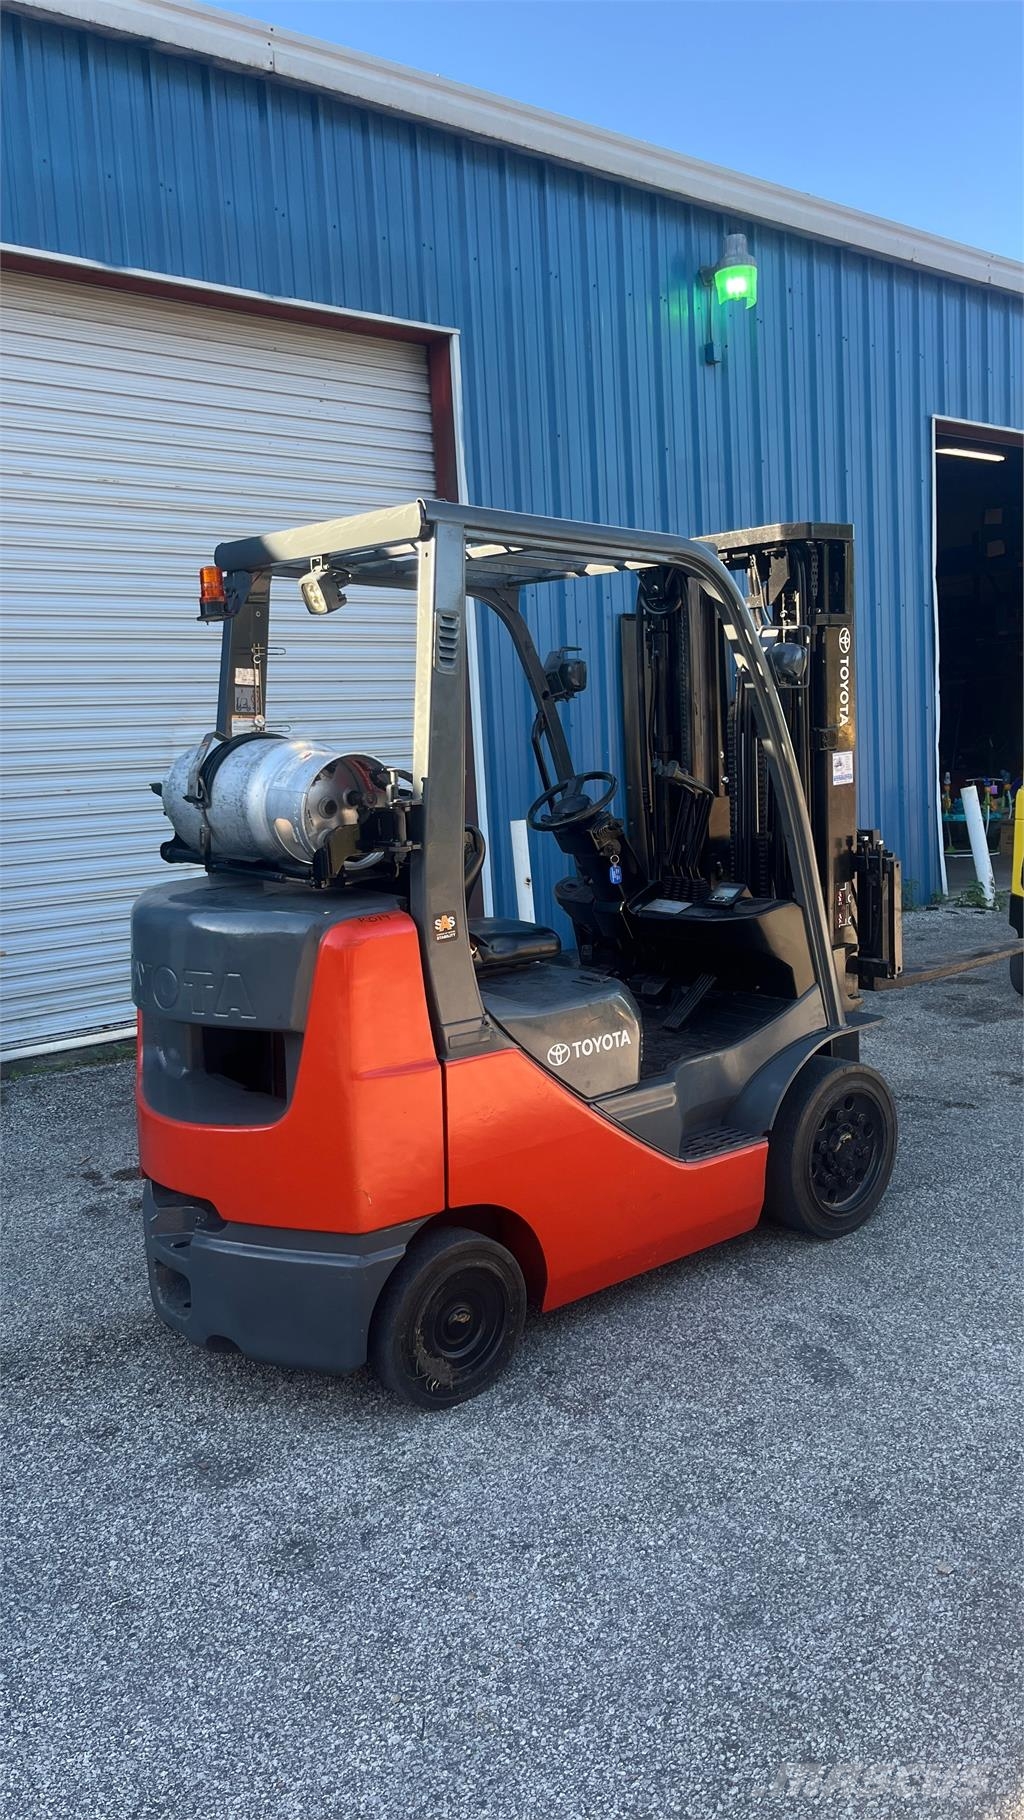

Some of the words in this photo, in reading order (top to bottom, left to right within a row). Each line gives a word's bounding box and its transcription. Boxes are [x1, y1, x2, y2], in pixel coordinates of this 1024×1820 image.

[839, 656, 850, 726] TOYOTA
[434, 915, 456, 931] SAS
[572, 1030, 631, 1058] TOYOTA
